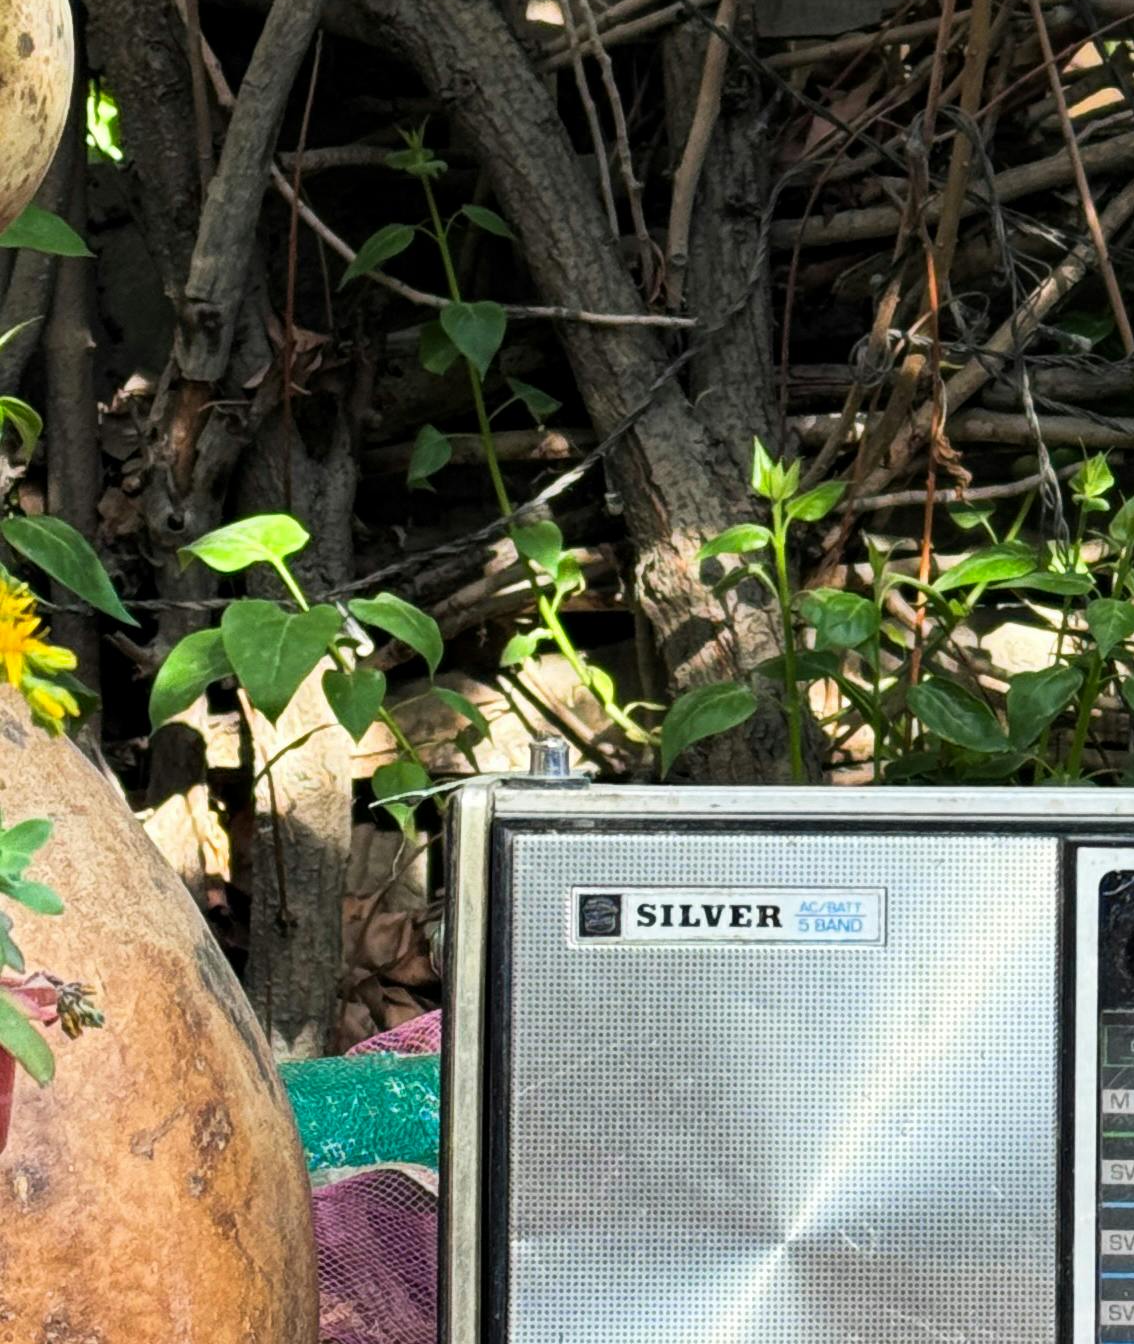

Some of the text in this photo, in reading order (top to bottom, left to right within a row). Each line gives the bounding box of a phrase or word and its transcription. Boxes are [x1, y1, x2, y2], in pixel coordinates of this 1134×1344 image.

[799, 901, 862, 913] AC/BATT
[636, 903, 783, 928] SILVER
[798, 918, 864, 933] 5 BAND
